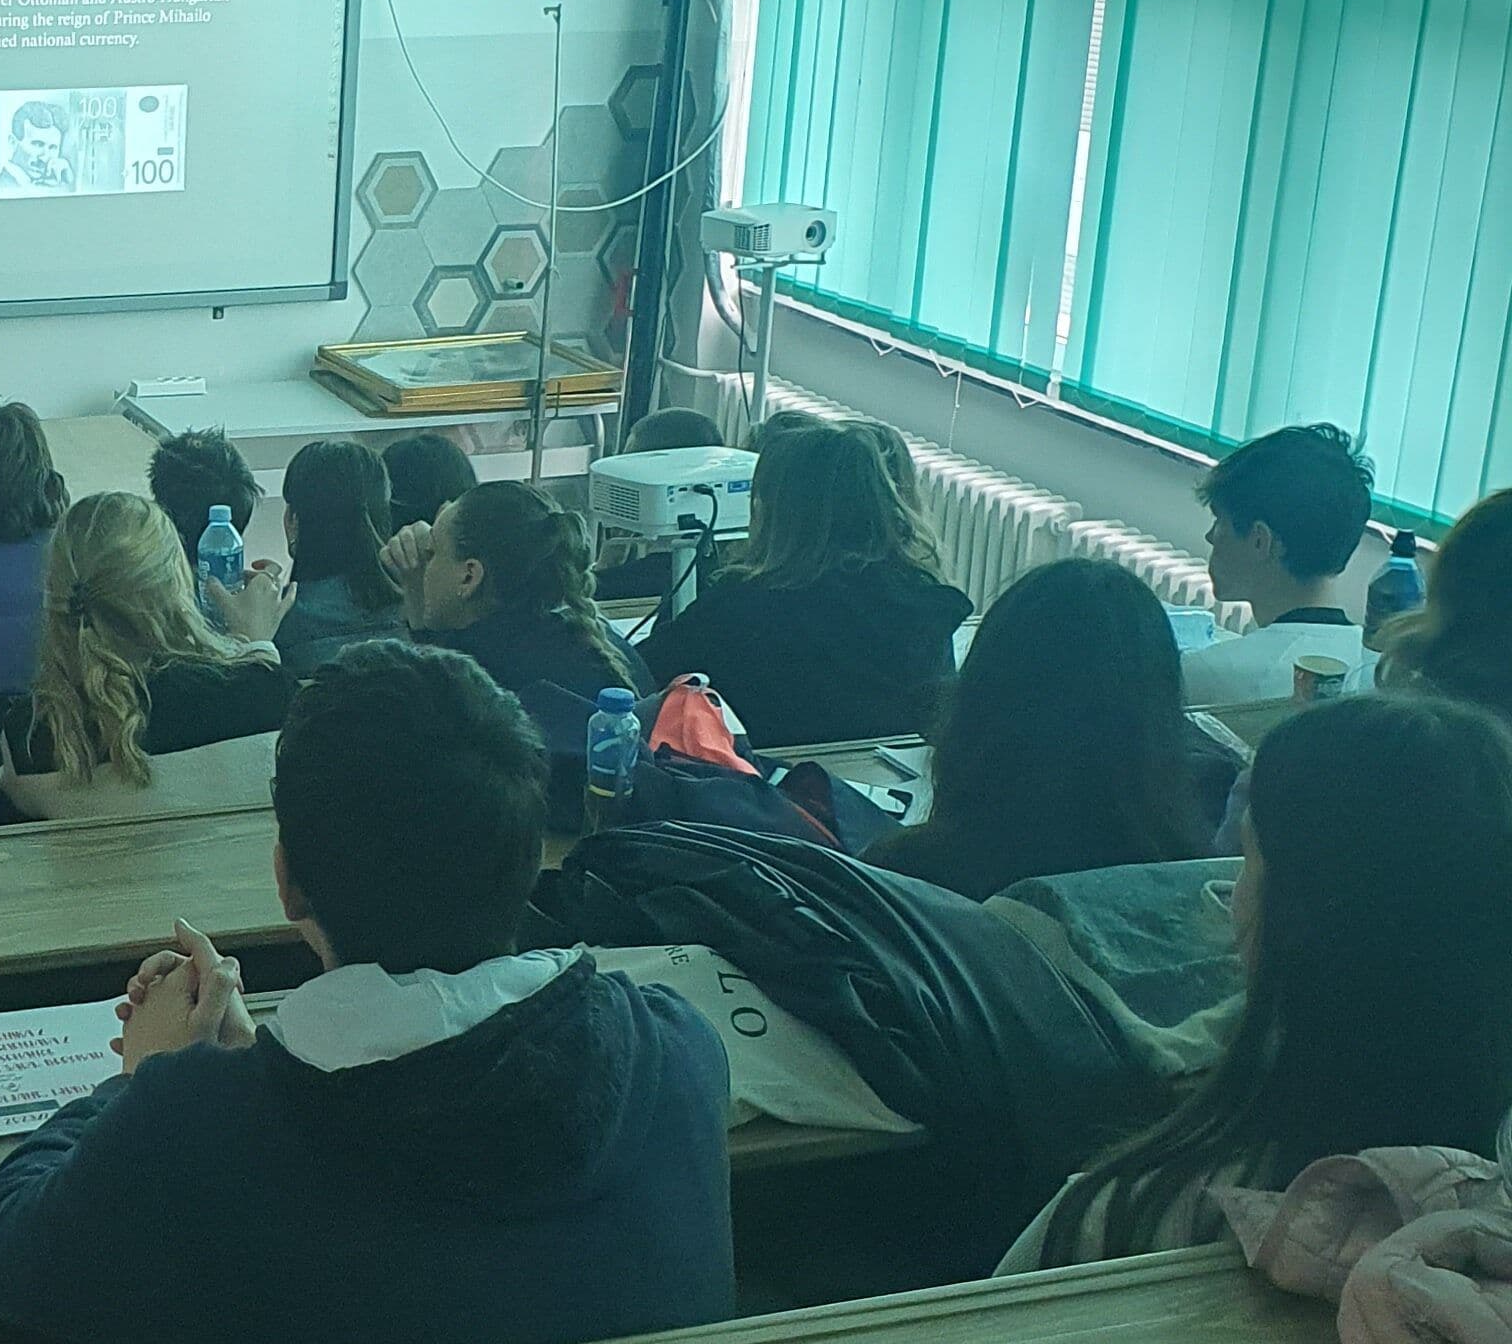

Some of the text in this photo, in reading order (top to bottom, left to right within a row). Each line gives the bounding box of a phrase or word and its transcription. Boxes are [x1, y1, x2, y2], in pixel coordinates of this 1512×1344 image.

[33, 12, 54, 26] the
[57, 12, 90, 28] reign
[95, 11, 110, 25] of
[114, 10, 155, 25] Prince
[159, 9, 211, 24] Mihailo
[22, 32, 76, 48] national
[79, 34, 139, 48] currency.
[132, 159, 175, 185] 100
